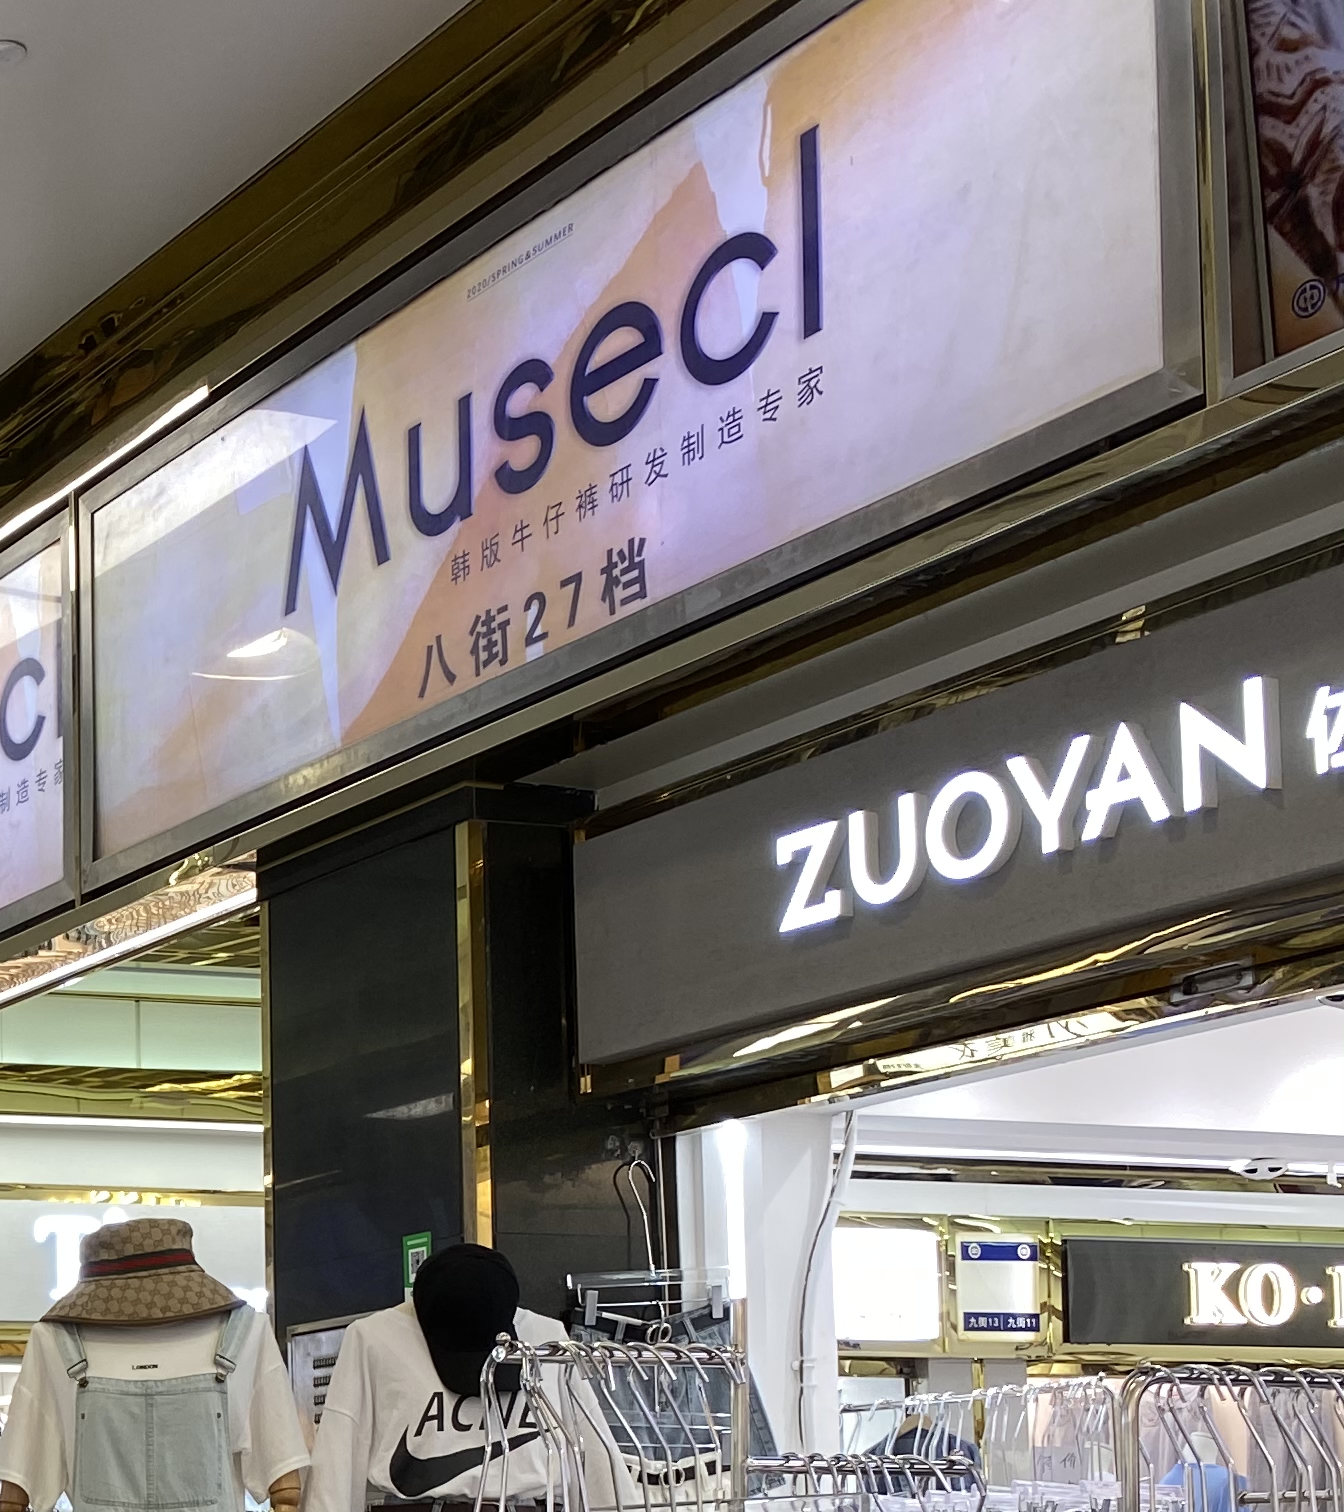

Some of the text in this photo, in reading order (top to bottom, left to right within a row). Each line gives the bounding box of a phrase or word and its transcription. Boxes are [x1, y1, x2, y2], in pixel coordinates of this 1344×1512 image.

[285, 125, 824, 617] Musecl
[467, 223, 574, 299] 2020/SPRING&SUMMER
[450, 365, 827, 586] 韩版牛仔裤研发制造专家
[420, 537, 649, 700] 八街27档
[776, 675, 1282, 933] ZUOYAN
